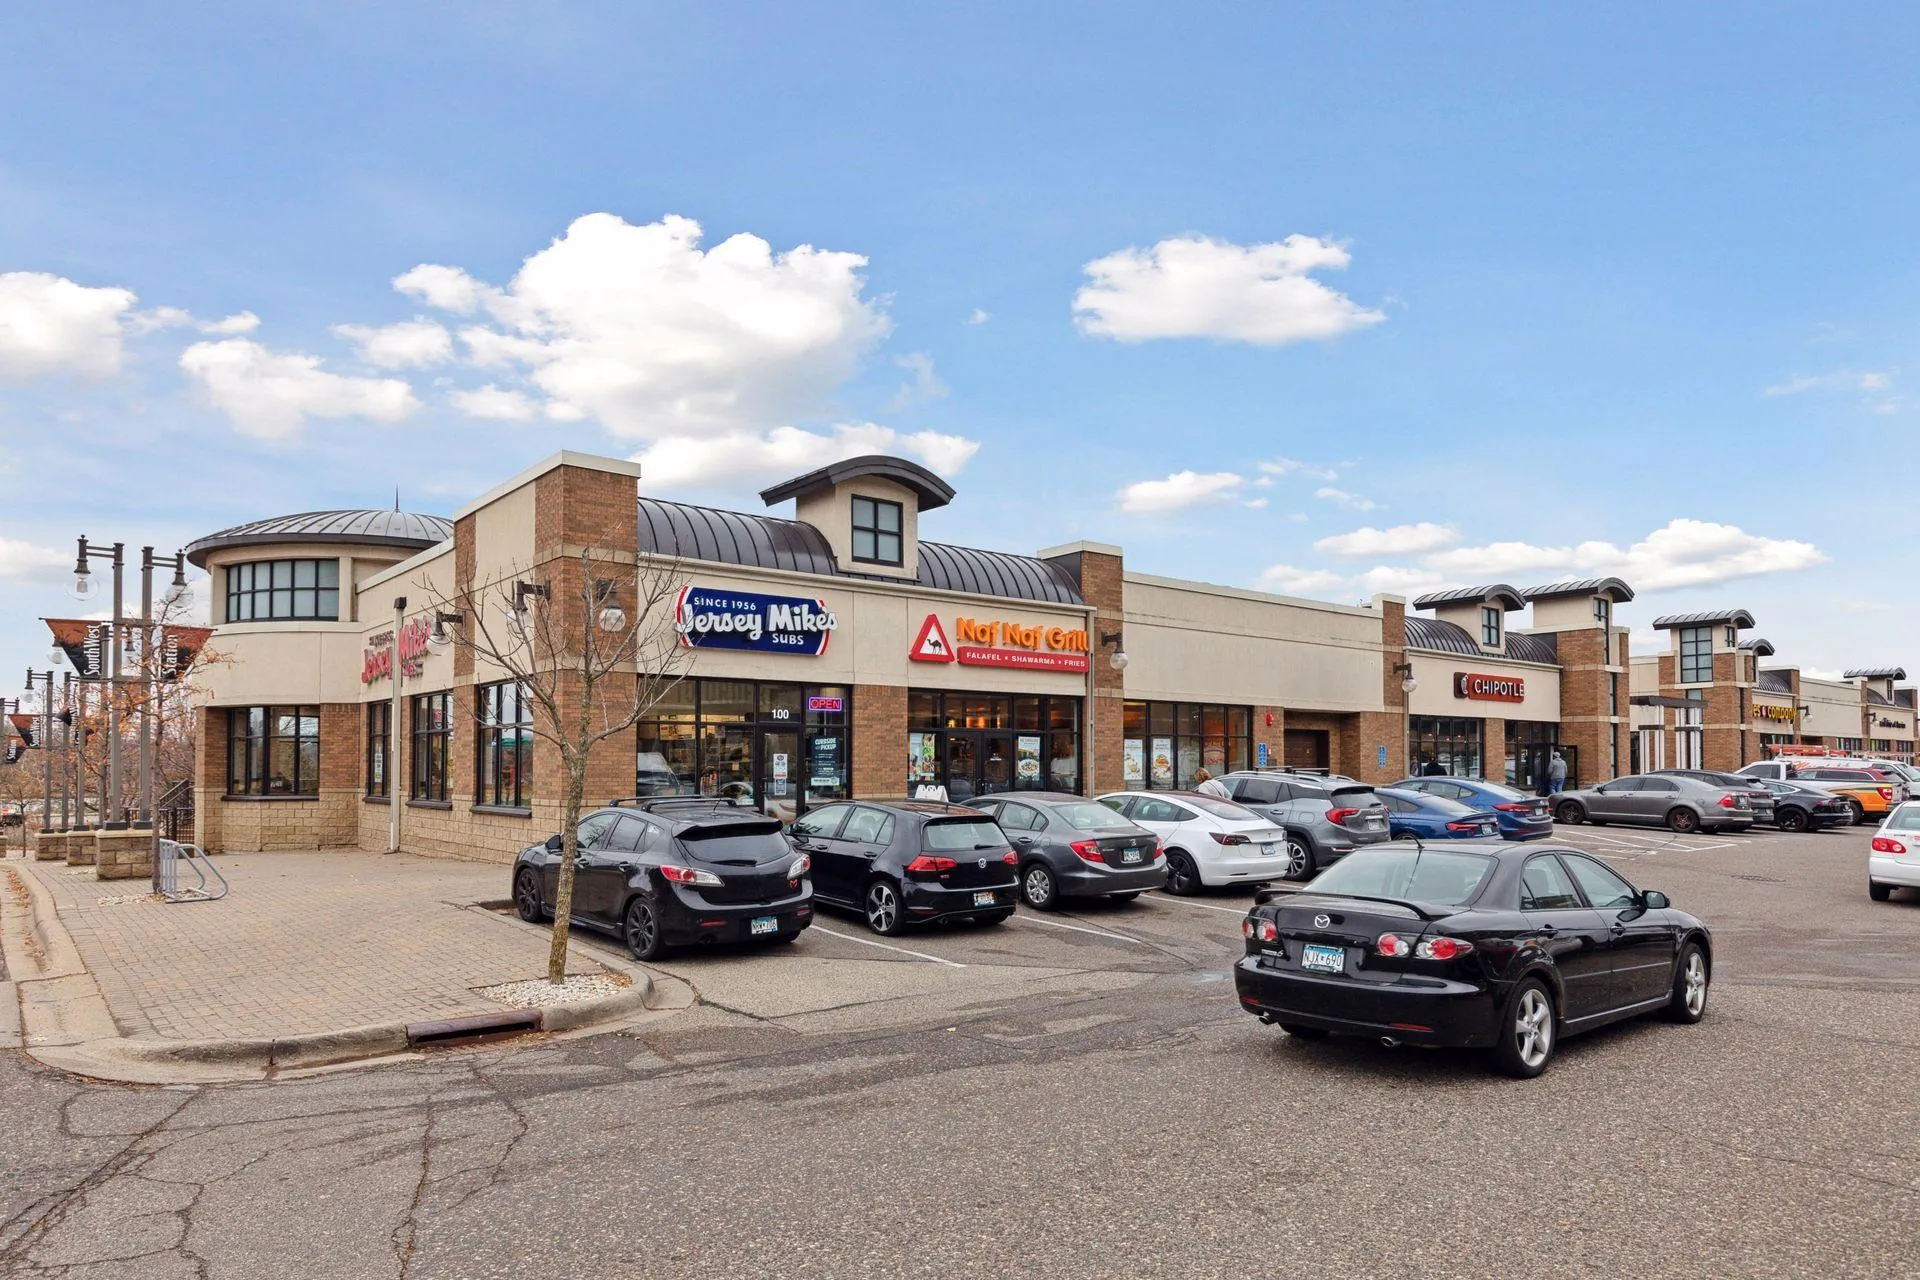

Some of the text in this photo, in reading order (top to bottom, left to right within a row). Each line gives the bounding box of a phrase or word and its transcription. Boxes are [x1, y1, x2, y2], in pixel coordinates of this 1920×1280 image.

[693, 597, 757, 611] SINCE 1956
[675, 604, 839, 641] Jersey Mike's
[772, 633, 804, 645] SUBS
[956, 616, 1089, 651] Naf Naf Grill
[83, 625, 101, 676] SouthWest
[162, 634, 179, 678] Station
[966, 652, 1086, 668] FALAFEL SHAWARMA FRIES
[1474, 679, 1524, 697] CHIPOTLE
[811, 699, 840, 709] OPEN
[772, 709, 790, 719] 100
[1325, 954, 1342, 967] 690
